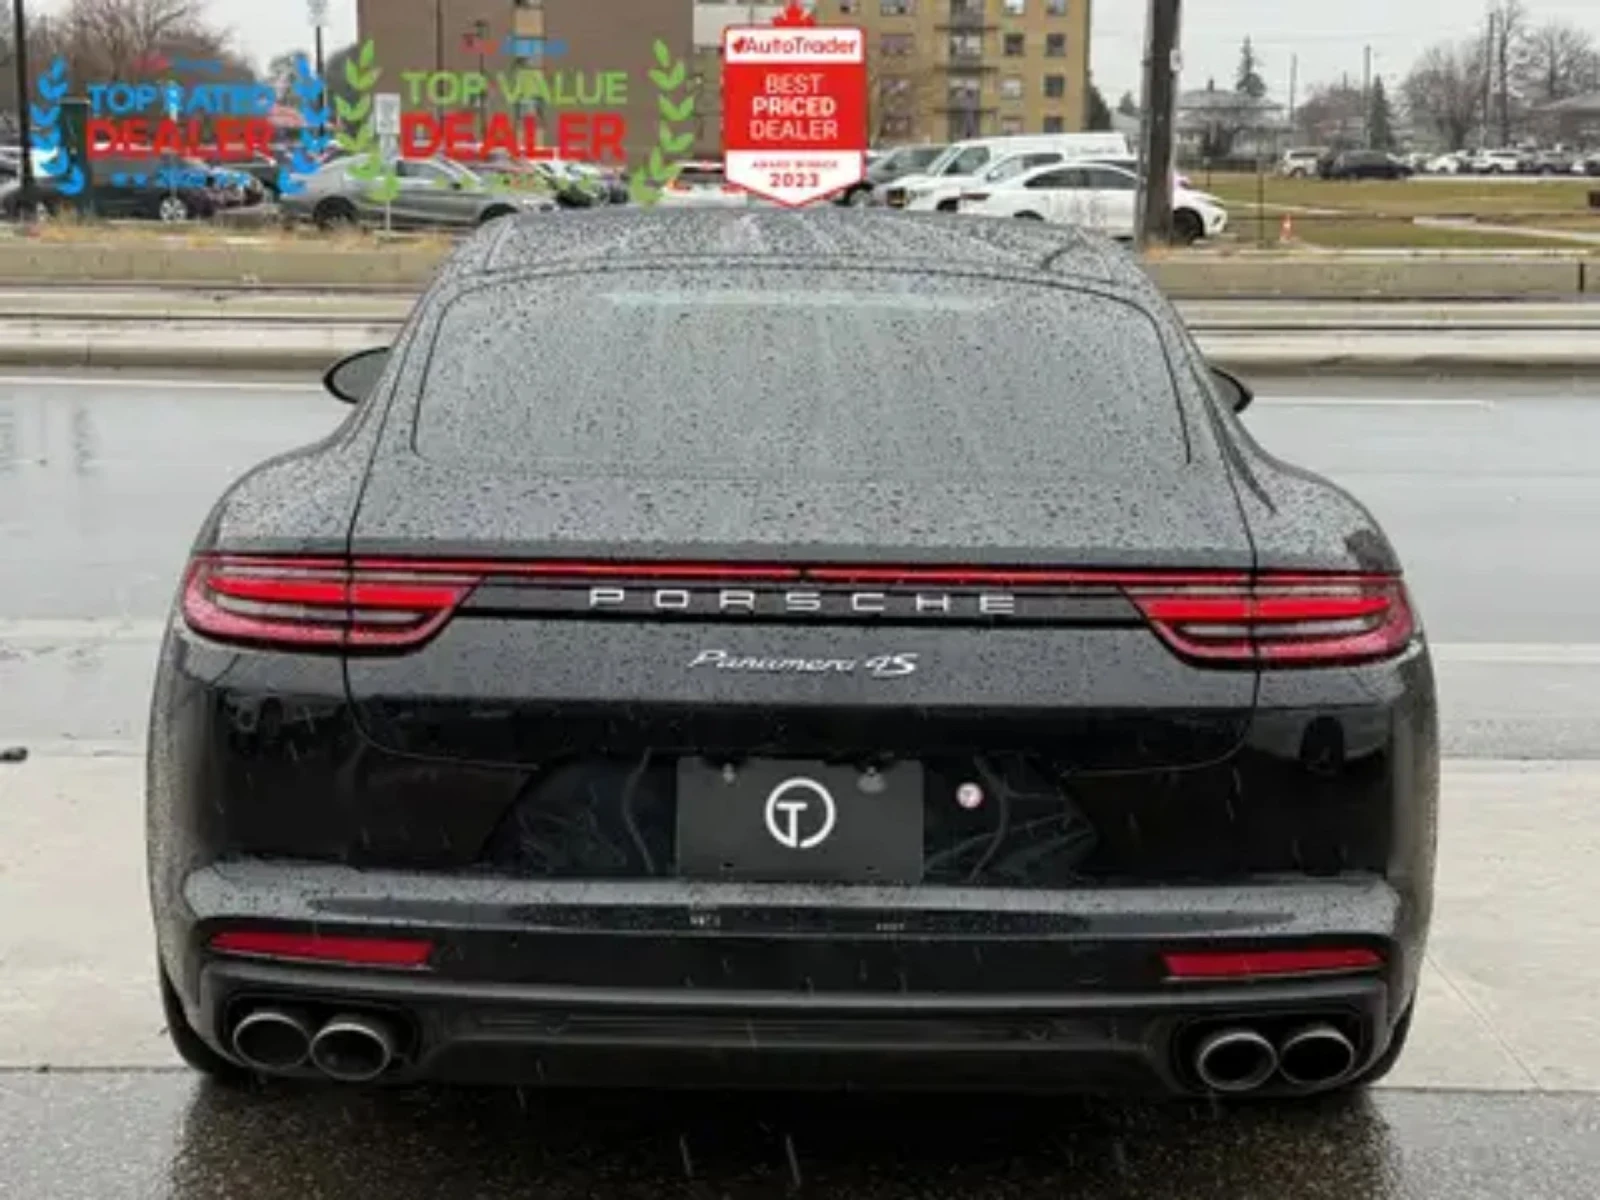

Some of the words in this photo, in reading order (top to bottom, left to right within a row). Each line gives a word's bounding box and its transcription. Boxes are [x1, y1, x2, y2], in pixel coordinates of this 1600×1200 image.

[589, 587, 1016, 614] PORSCHE
[686, 649, 857, 672] Panamera
[863, 652, 919, 677] 4S
